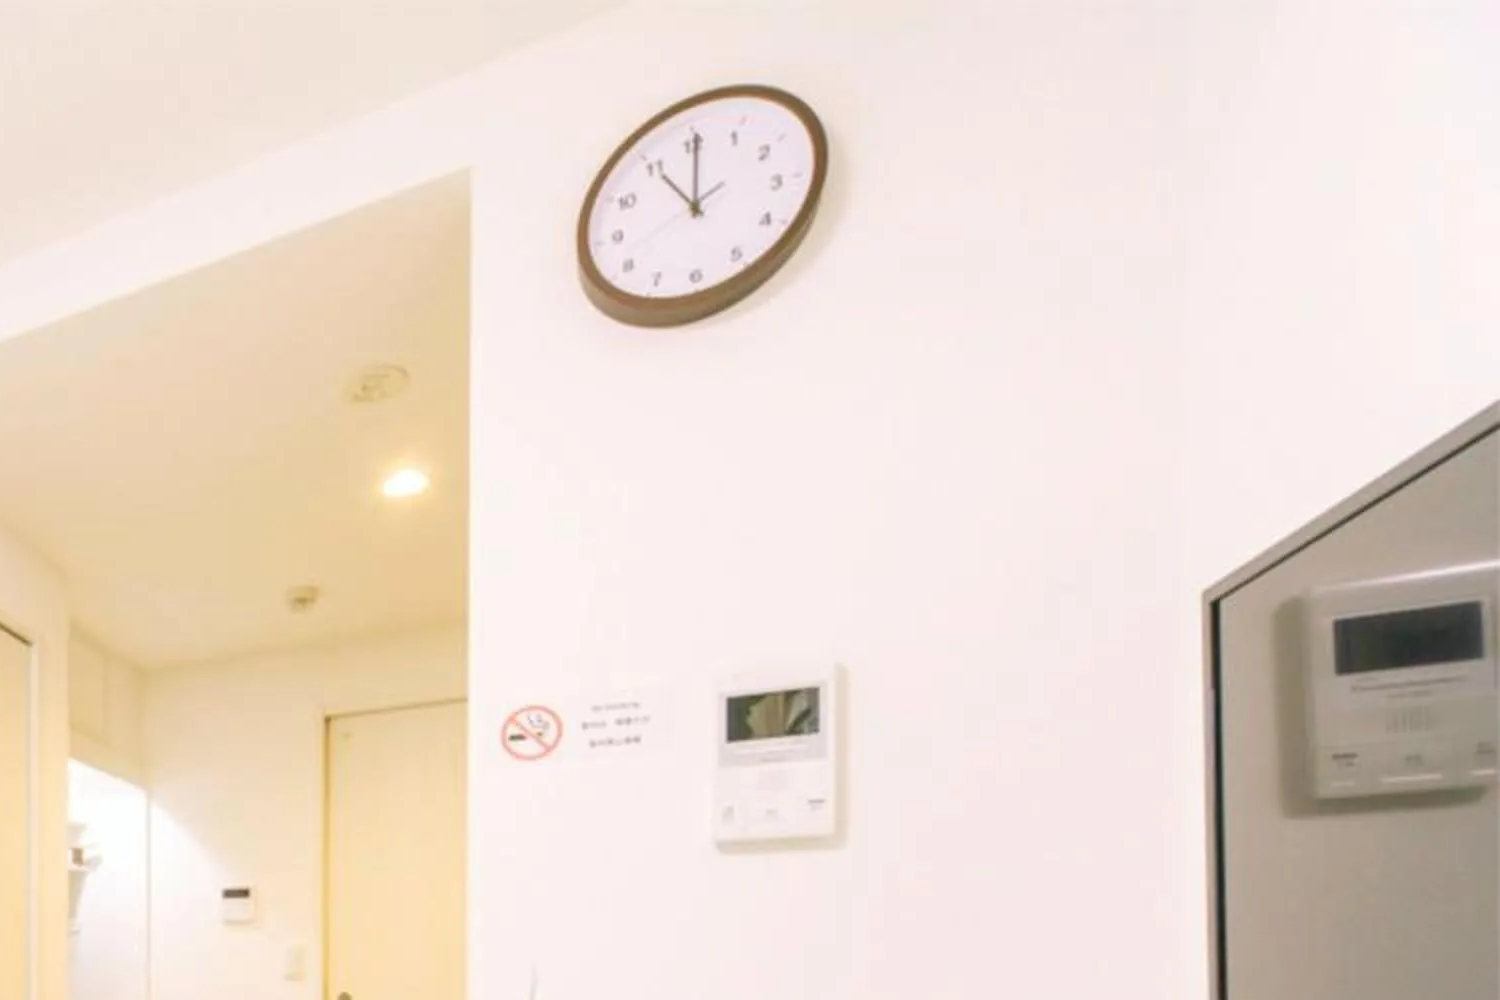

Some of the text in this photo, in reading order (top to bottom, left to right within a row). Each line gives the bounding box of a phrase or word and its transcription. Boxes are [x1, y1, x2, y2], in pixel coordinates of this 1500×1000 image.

[730, 131, 739, 147] 1
[759, 144, 771, 162] 2
[646, 159, 663, 176] 11
[771, 174, 783, 191] 3
[618, 193, 637, 210] 10
[759, 211, 772, 226] 4
[612, 229, 624, 243] 9
[730, 246, 743, 262] 5
[622, 258, 634, 272] 8
[652, 271, 662, 287] 7
[689, 269, 703, 283] 6
